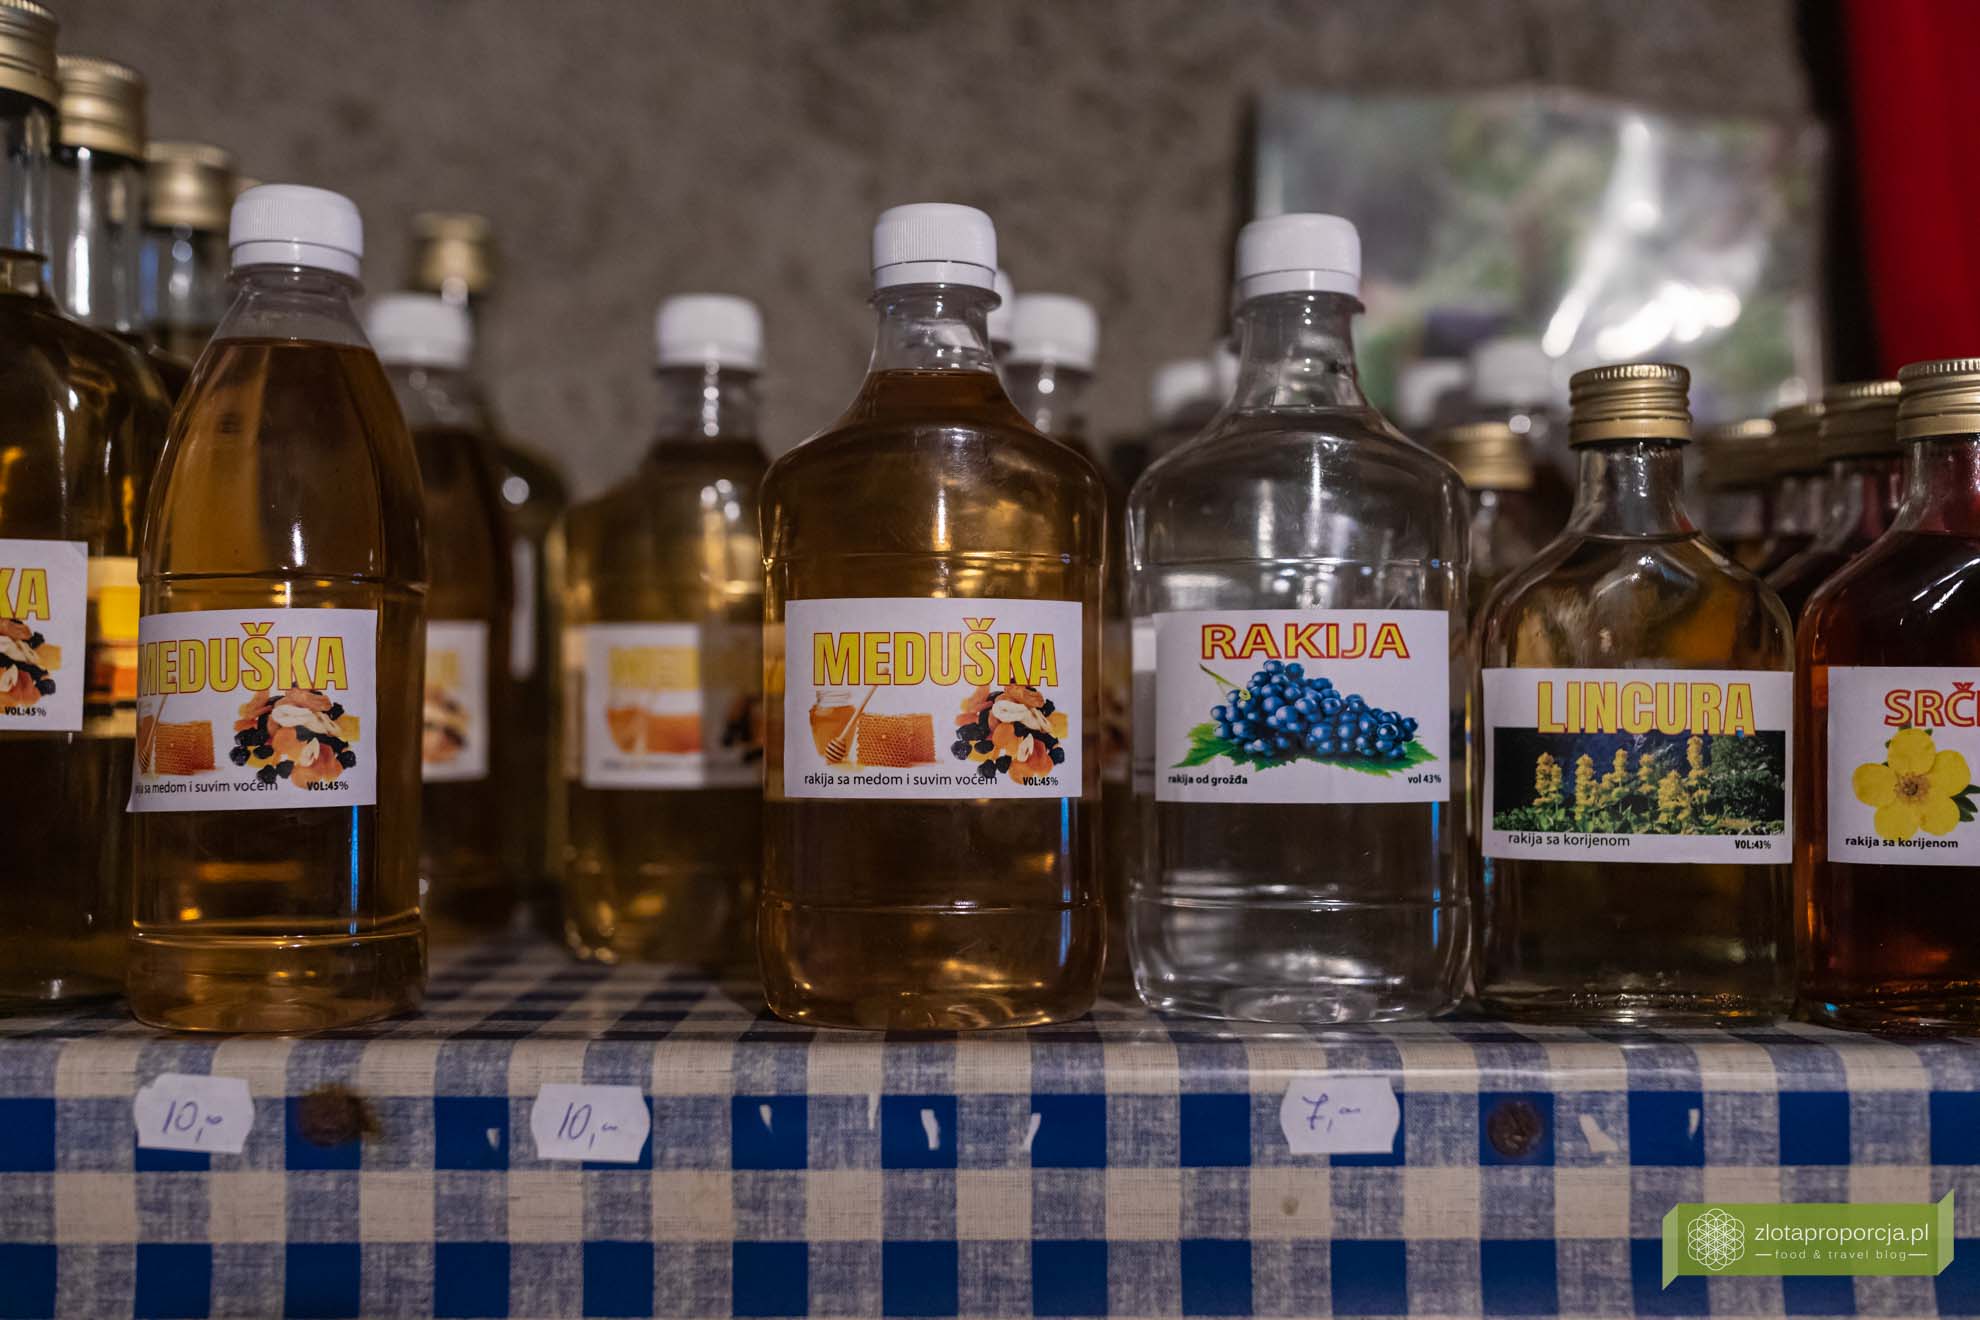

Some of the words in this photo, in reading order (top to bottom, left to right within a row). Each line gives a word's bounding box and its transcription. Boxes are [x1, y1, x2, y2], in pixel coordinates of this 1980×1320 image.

[1201, 623, 1410, 660] RAKIJA
[813, 617, 1058, 687] MEDUŠKA
[4, 706, 47, 717] VOL:45%
[1537, 681, 1756, 736] LINCURA
[1884, 682, 1980, 728] SRČ
[804, 772, 834, 787] rakija
[837, 775, 850, 785] sa
[853, 773, 903, 785] medom
[906, 773, 910, 785] i
[913, 774, 952, 785] suvim
[955, 773, 998, 785] voćem
[1023, 776, 1059, 786] VOL:45%
[1168, 774, 1193, 786] rakija
[1196, 774, 1209, 784] od
[1408, 773, 1421, 784] vol
[1423, 774, 1442, 784] 43%
[152, 781, 187, 793] medom
[189, 781, 192, 792] i
[195, 780, 230, 792] suvim
[306, 781, 349, 791] VOL:45%
[1508, 832, 1543, 846] rakija
[1547, 834, 1559, 845] sa
[1563, 834, 1630, 848] korijenom
[1735, 839, 1772, 850] VOL:43%
[1845, 836, 1880, 848] rakija
[1883, 838, 1895, 847] sa
[1898, 837, 1959, 849] korijenom
